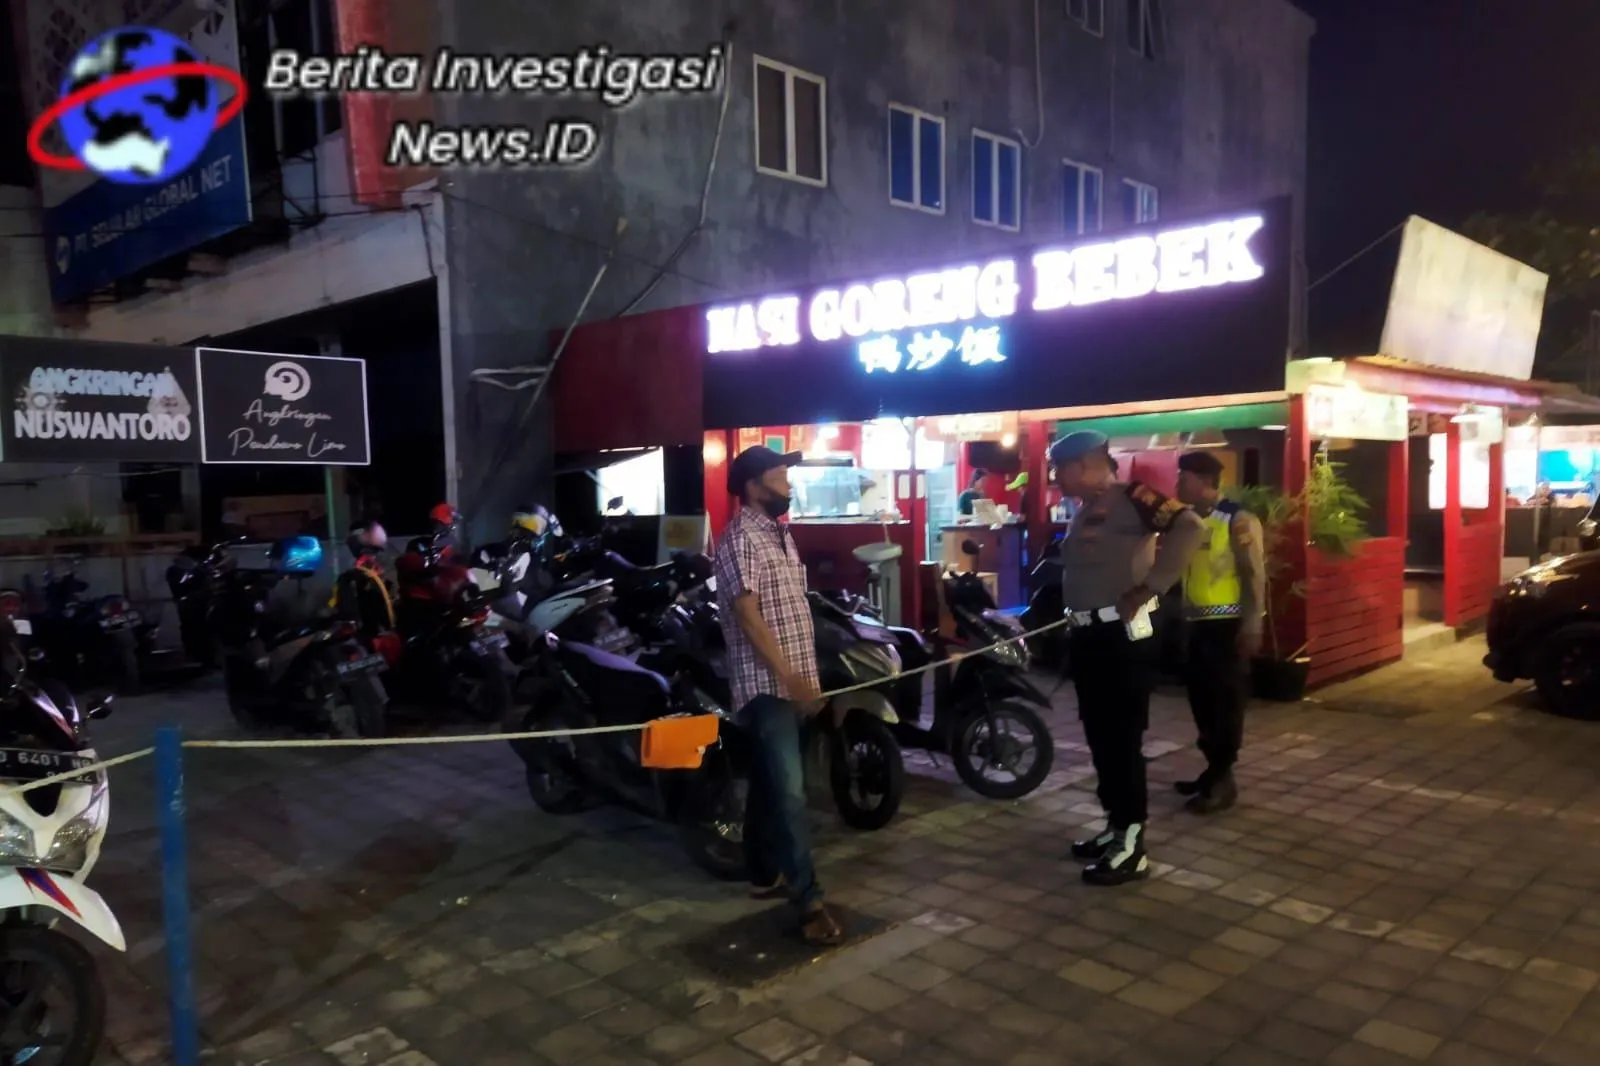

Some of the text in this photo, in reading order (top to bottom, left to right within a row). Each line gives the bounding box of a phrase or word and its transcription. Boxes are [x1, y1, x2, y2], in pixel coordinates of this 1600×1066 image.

[143, 175, 199, 221] GLOBAL
[200, 154, 232, 194] NET
[707, 216, 1264, 354] NASI GORENG BEBEK
[30, 366, 176, 397] ANGKRINGAN
[14, 410, 192, 441] NUSWANTORO
